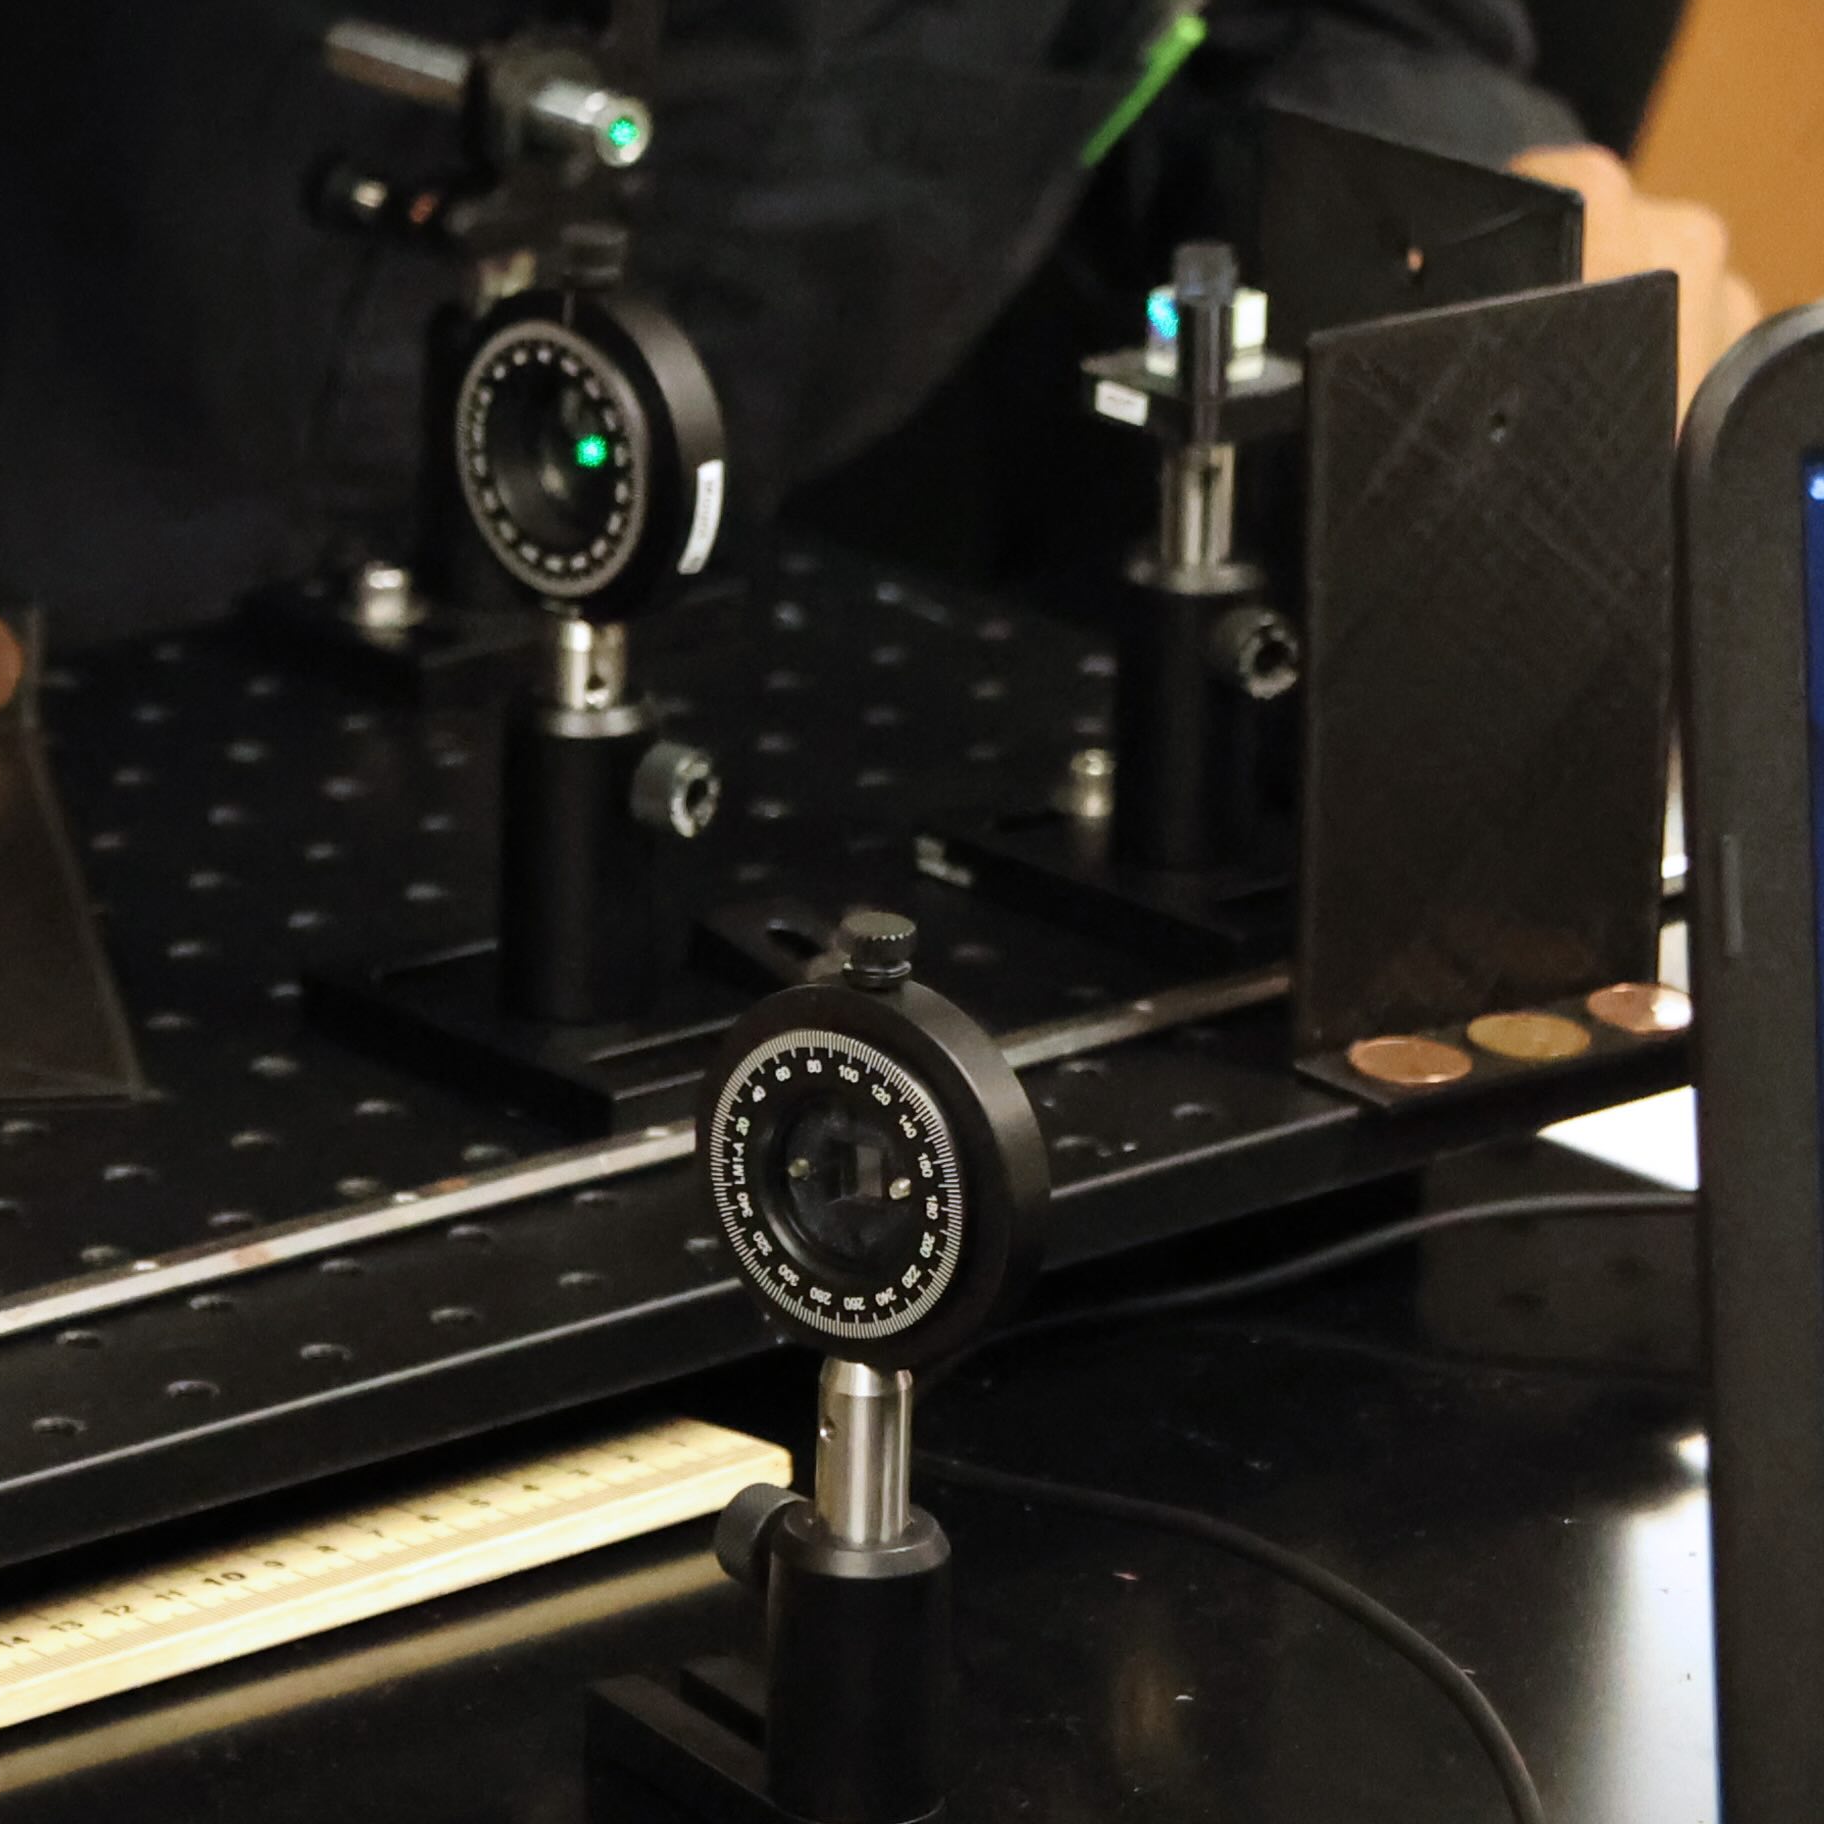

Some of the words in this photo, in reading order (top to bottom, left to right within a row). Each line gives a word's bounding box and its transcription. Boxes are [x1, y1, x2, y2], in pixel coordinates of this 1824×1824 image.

[838, 1064, 859, 1083] 100
[871, 1083, 891, 1106] 120
[898, 1114, 917, 1139] 140
[736, 1192, 754, 1219] 340
[752, 1230, 773, 1257] 320
[919, 1231, 936, 1259] 200
[777, 1263, 800, 1288] 300
[901, 1264, 922, 1289] 220
[47, 1620, 84, 1633] 13
[101, 1604, 136, 1618] 12
[154, 1588, 187, 1601] 11
[203, 1571, 247, 1587] 10
